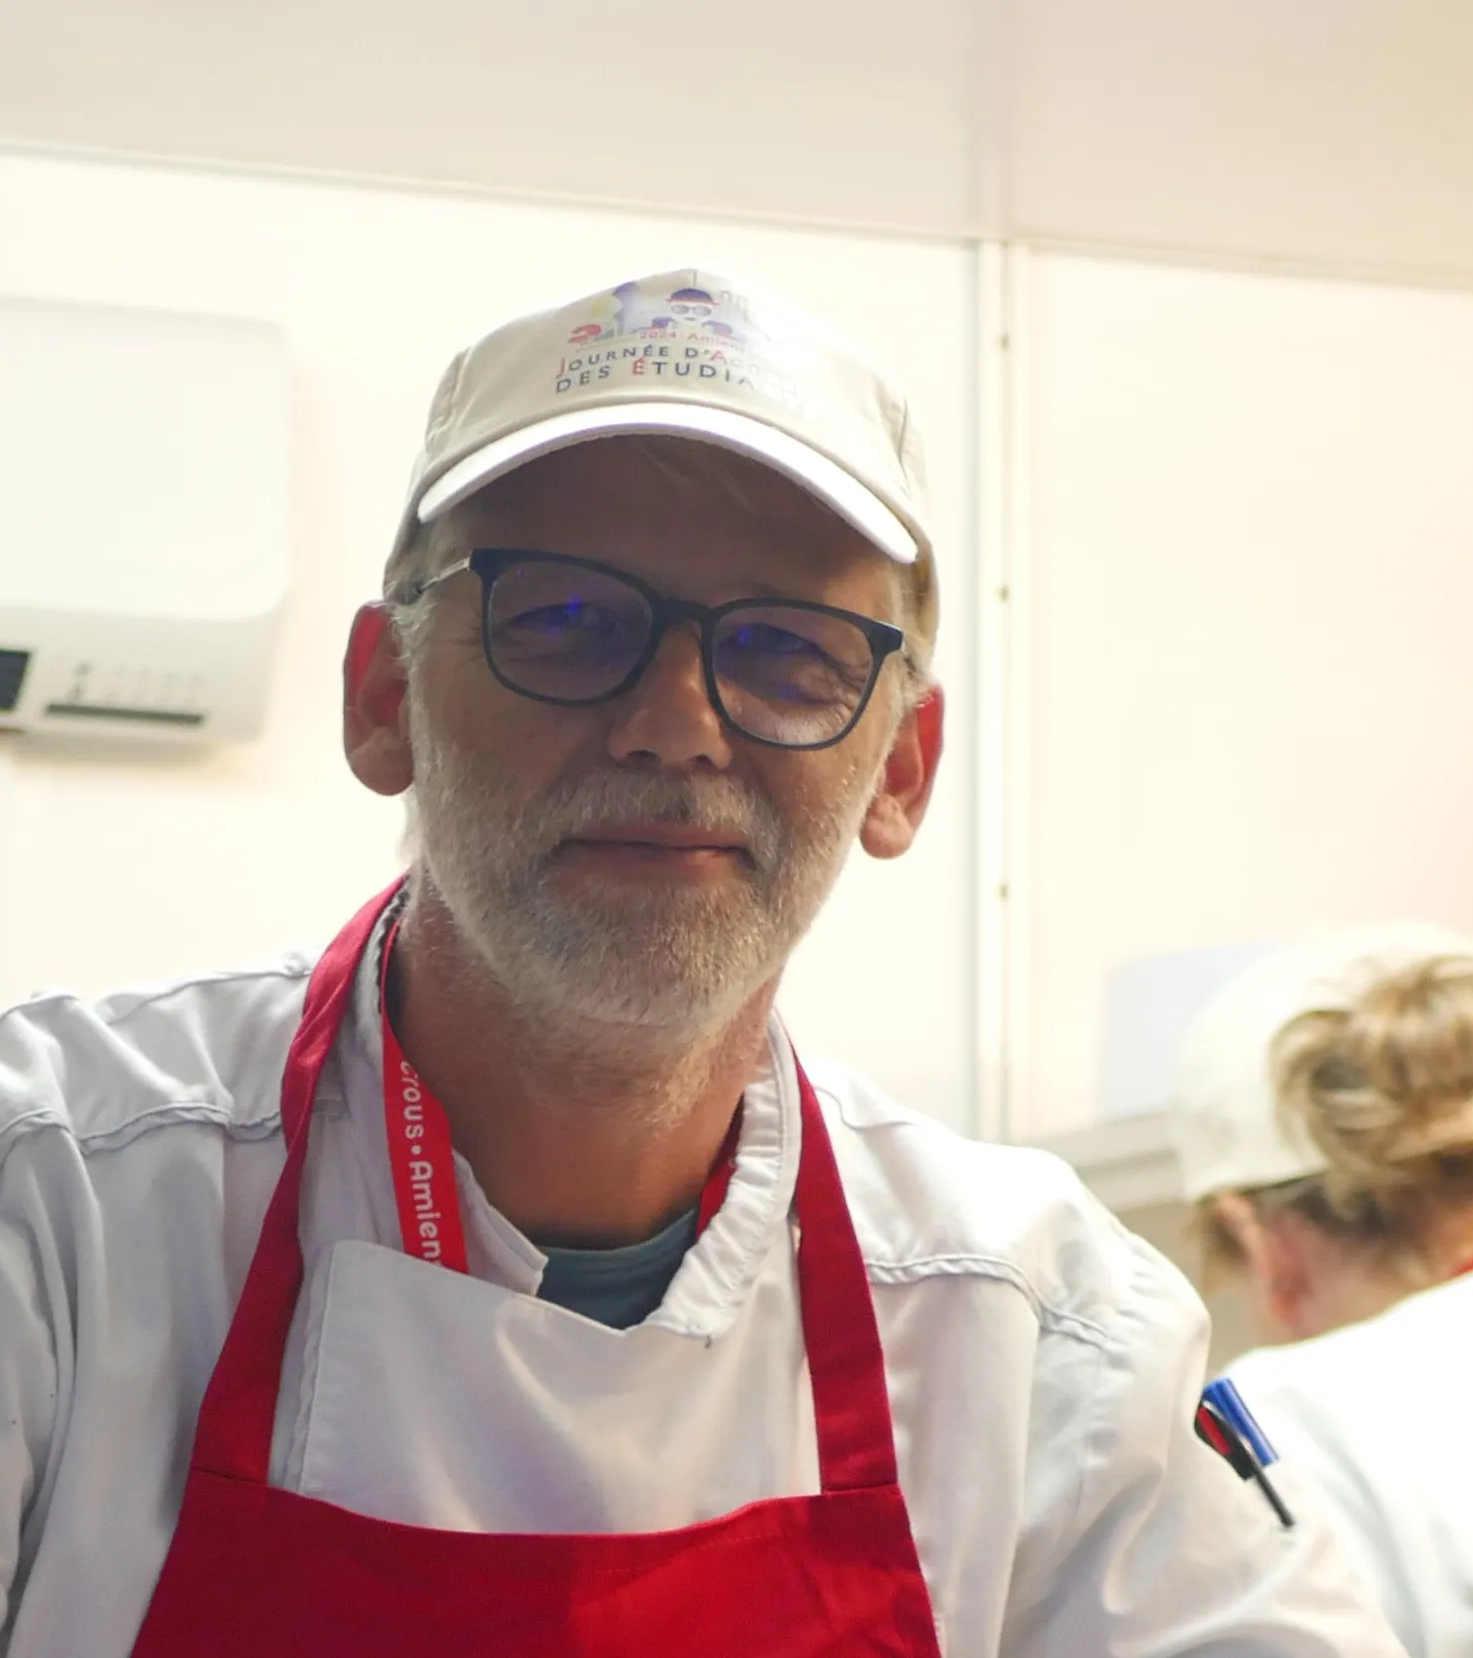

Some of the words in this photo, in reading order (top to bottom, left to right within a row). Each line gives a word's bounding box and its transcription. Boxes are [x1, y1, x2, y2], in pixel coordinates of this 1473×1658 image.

[639, 330, 677, 340] 2024
[555, 344, 670, 379] JOURNÉE
[555, 364, 611, 394] DES
[632, 355, 757, 391] ÉTUDIA
[409, 1160, 444, 1268] Amien
